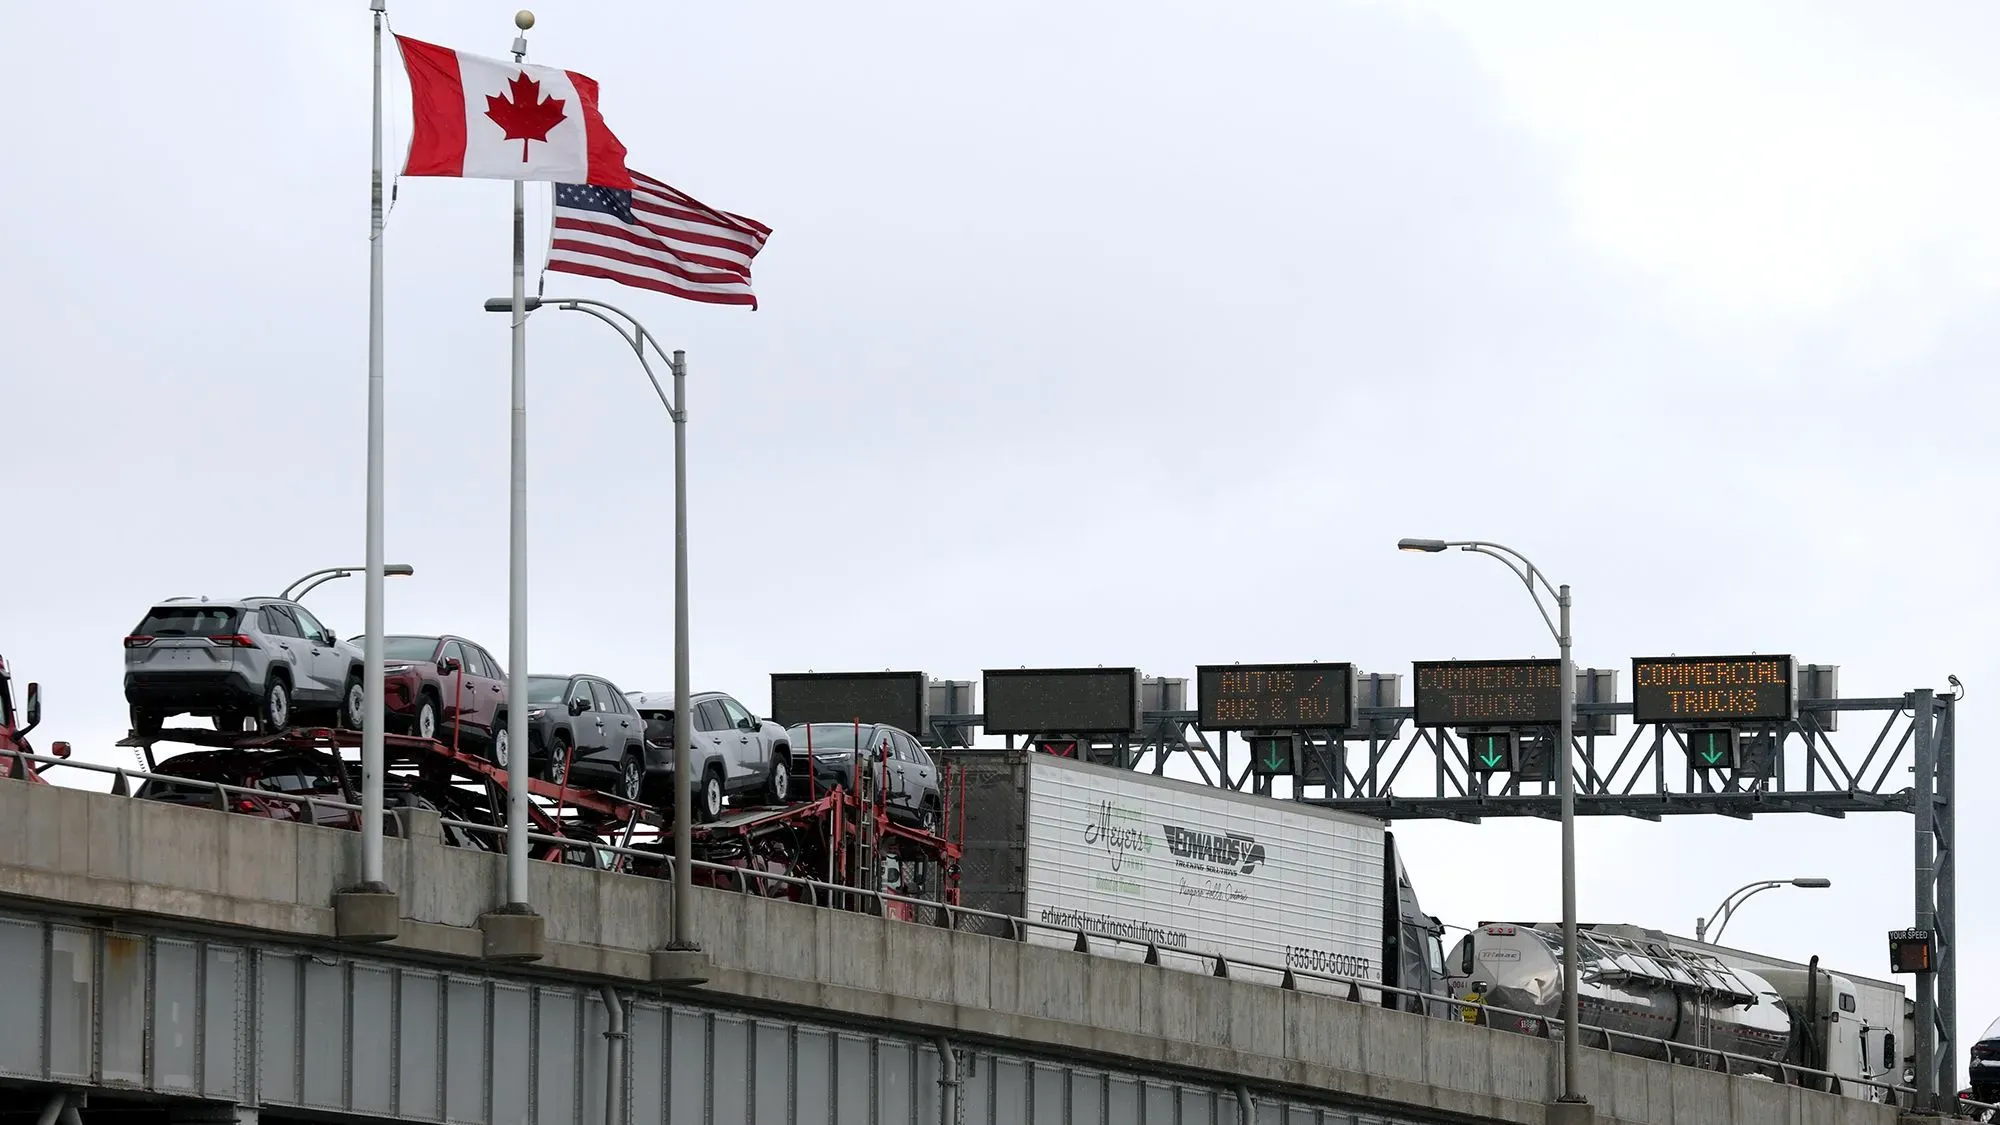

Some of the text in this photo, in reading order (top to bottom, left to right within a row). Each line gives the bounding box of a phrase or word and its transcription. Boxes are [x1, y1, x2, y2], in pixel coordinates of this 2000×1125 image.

[1222, 671, 1323, 693] AUTOS /
[1419, 666, 1561, 689] COMMERCIAL
[1638, 661, 1786, 686] COMMERCIAL
[1217, 697, 1329, 720] BUS & RV
[1448, 694, 1536, 717] TRUCKS
[1667, 690, 1757, 713] TRUCKS
[1084, 800, 1144, 872] Meyers
[1174, 827, 1241, 867] EDWARDS
[1175, 859, 1239, 877] TRUCKING SOLUTIONS
[1041, 905, 1188, 949] edwardstruckingsolutions.com
[1890, 931, 1928, 940] YOUR SPEED
[1285, 945, 1370, 980] 8-555-DO-GOODER
